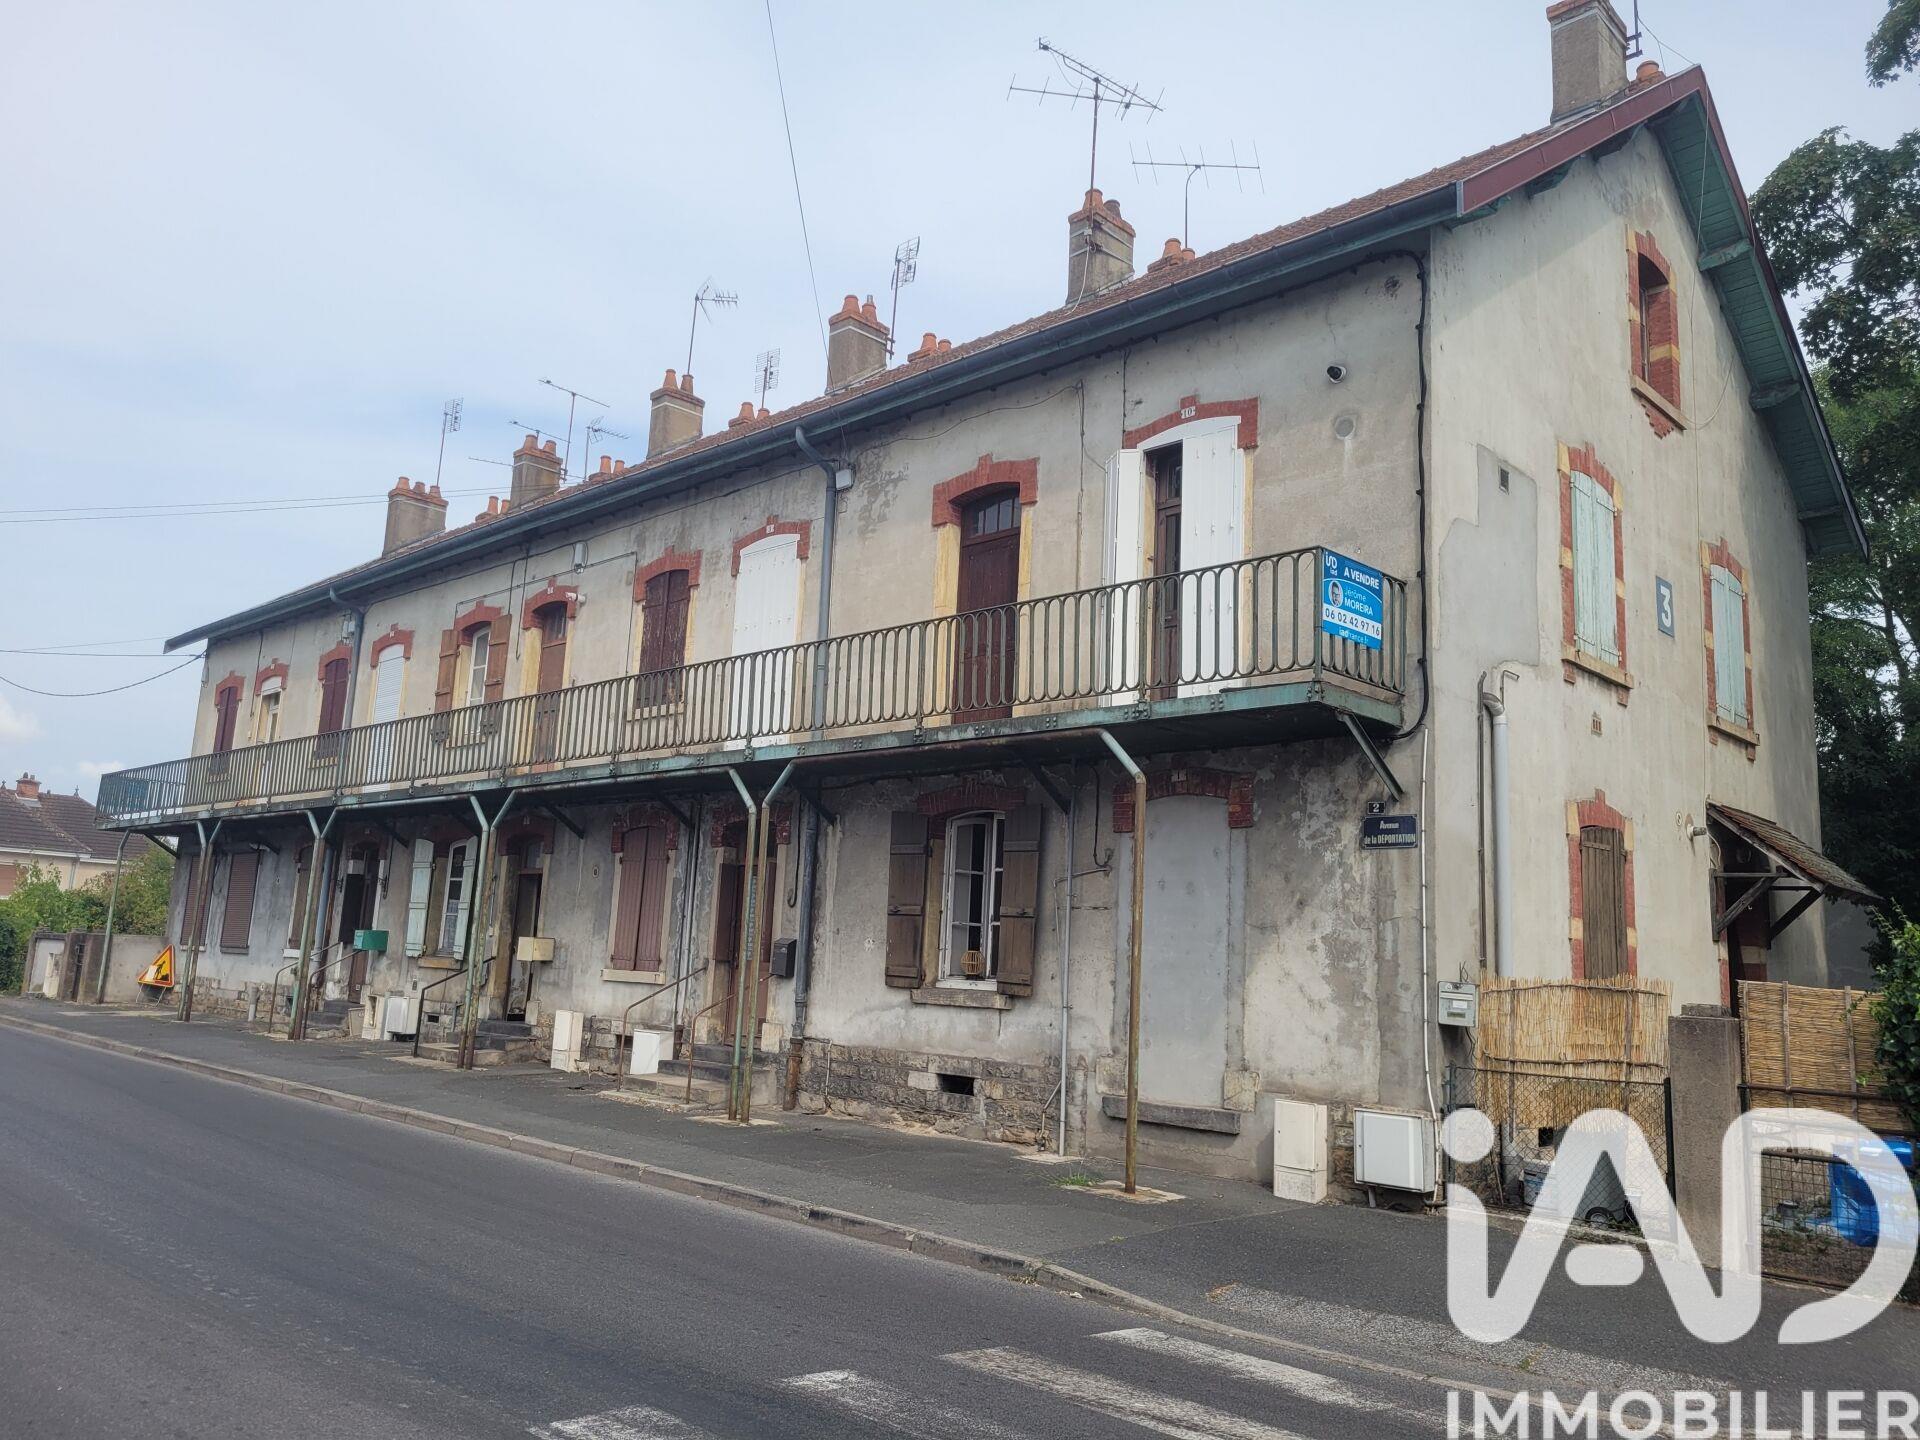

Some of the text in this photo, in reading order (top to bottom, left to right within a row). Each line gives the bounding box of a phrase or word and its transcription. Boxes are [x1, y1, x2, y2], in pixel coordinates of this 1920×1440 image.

[1344, 567, 1380, 590] A VENDRE
[1344, 597, 1374, 616] MOREIRA
[1660, 584, 1672, 628] 3
[1325, 608, 1380, 636] 06 02 42 97 16
[1372, 803, 1380, 813] 2
[1364, 835, 1371, 845] de
[1371, 834, 1377, 845] la
